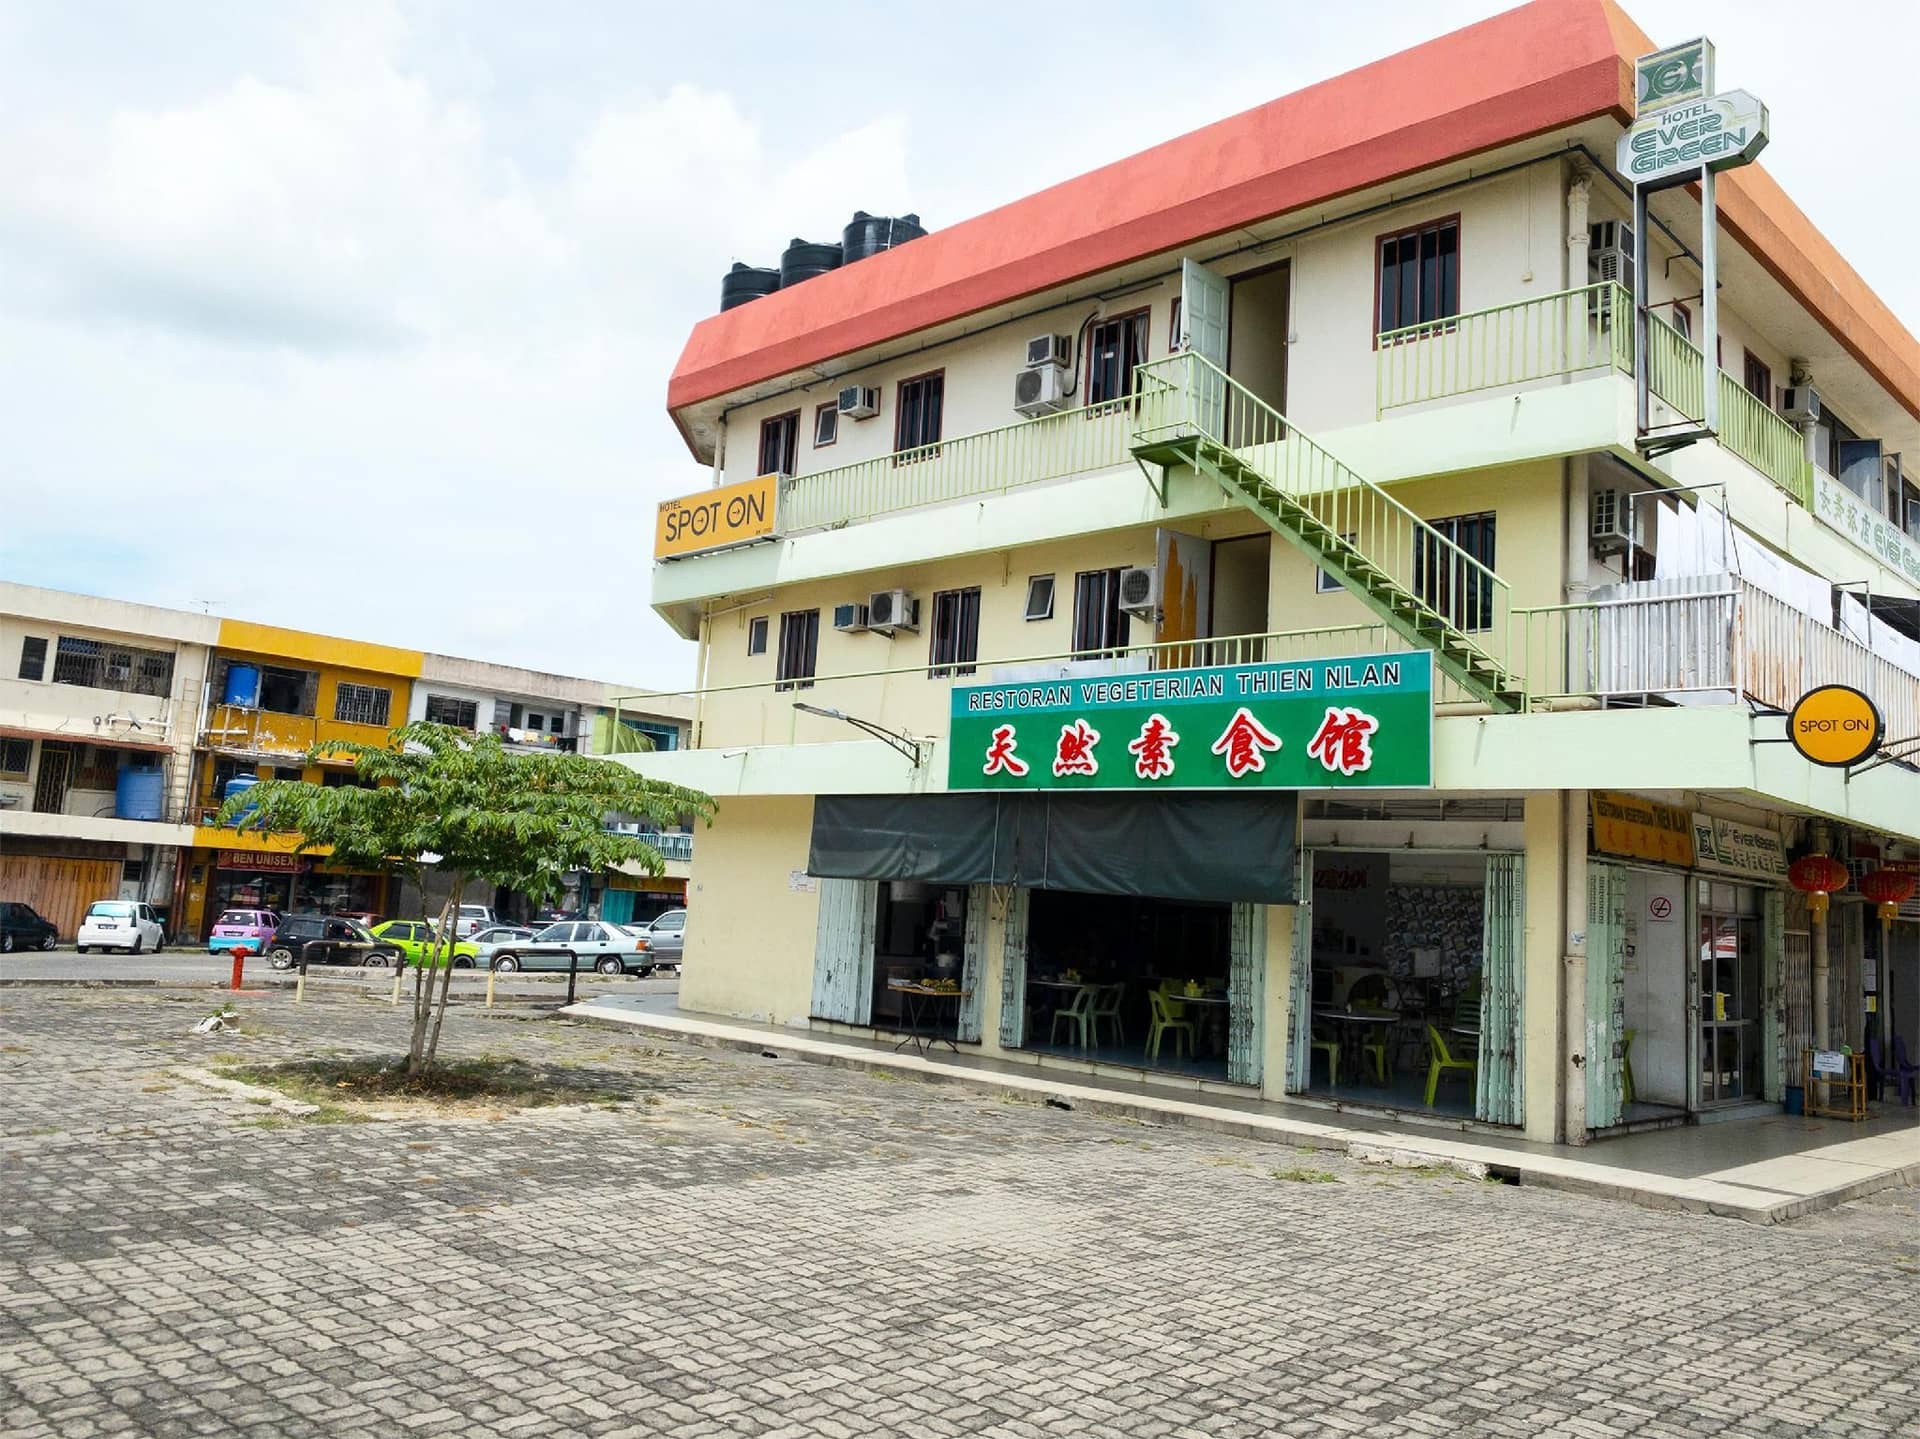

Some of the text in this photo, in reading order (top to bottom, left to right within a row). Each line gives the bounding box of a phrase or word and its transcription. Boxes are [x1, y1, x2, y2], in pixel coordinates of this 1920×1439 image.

[1630, 113, 1722, 153] EVER
[1662, 104, 1713, 125] HOTEL
[1631, 127, 1746, 174] GREEN
[660, 500, 682, 513] HOTEL
[665, 491, 765, 542] SPOT ON
[969, 661, 1400, 711] RESTORAN VEGETERIAN THIEN NLAN
[983, 706, 1379, 780] 天然素食馆
[1800, 719, 1869, 733] SPOT ON
[233, 852, 294, 866] BEN UNISEX
